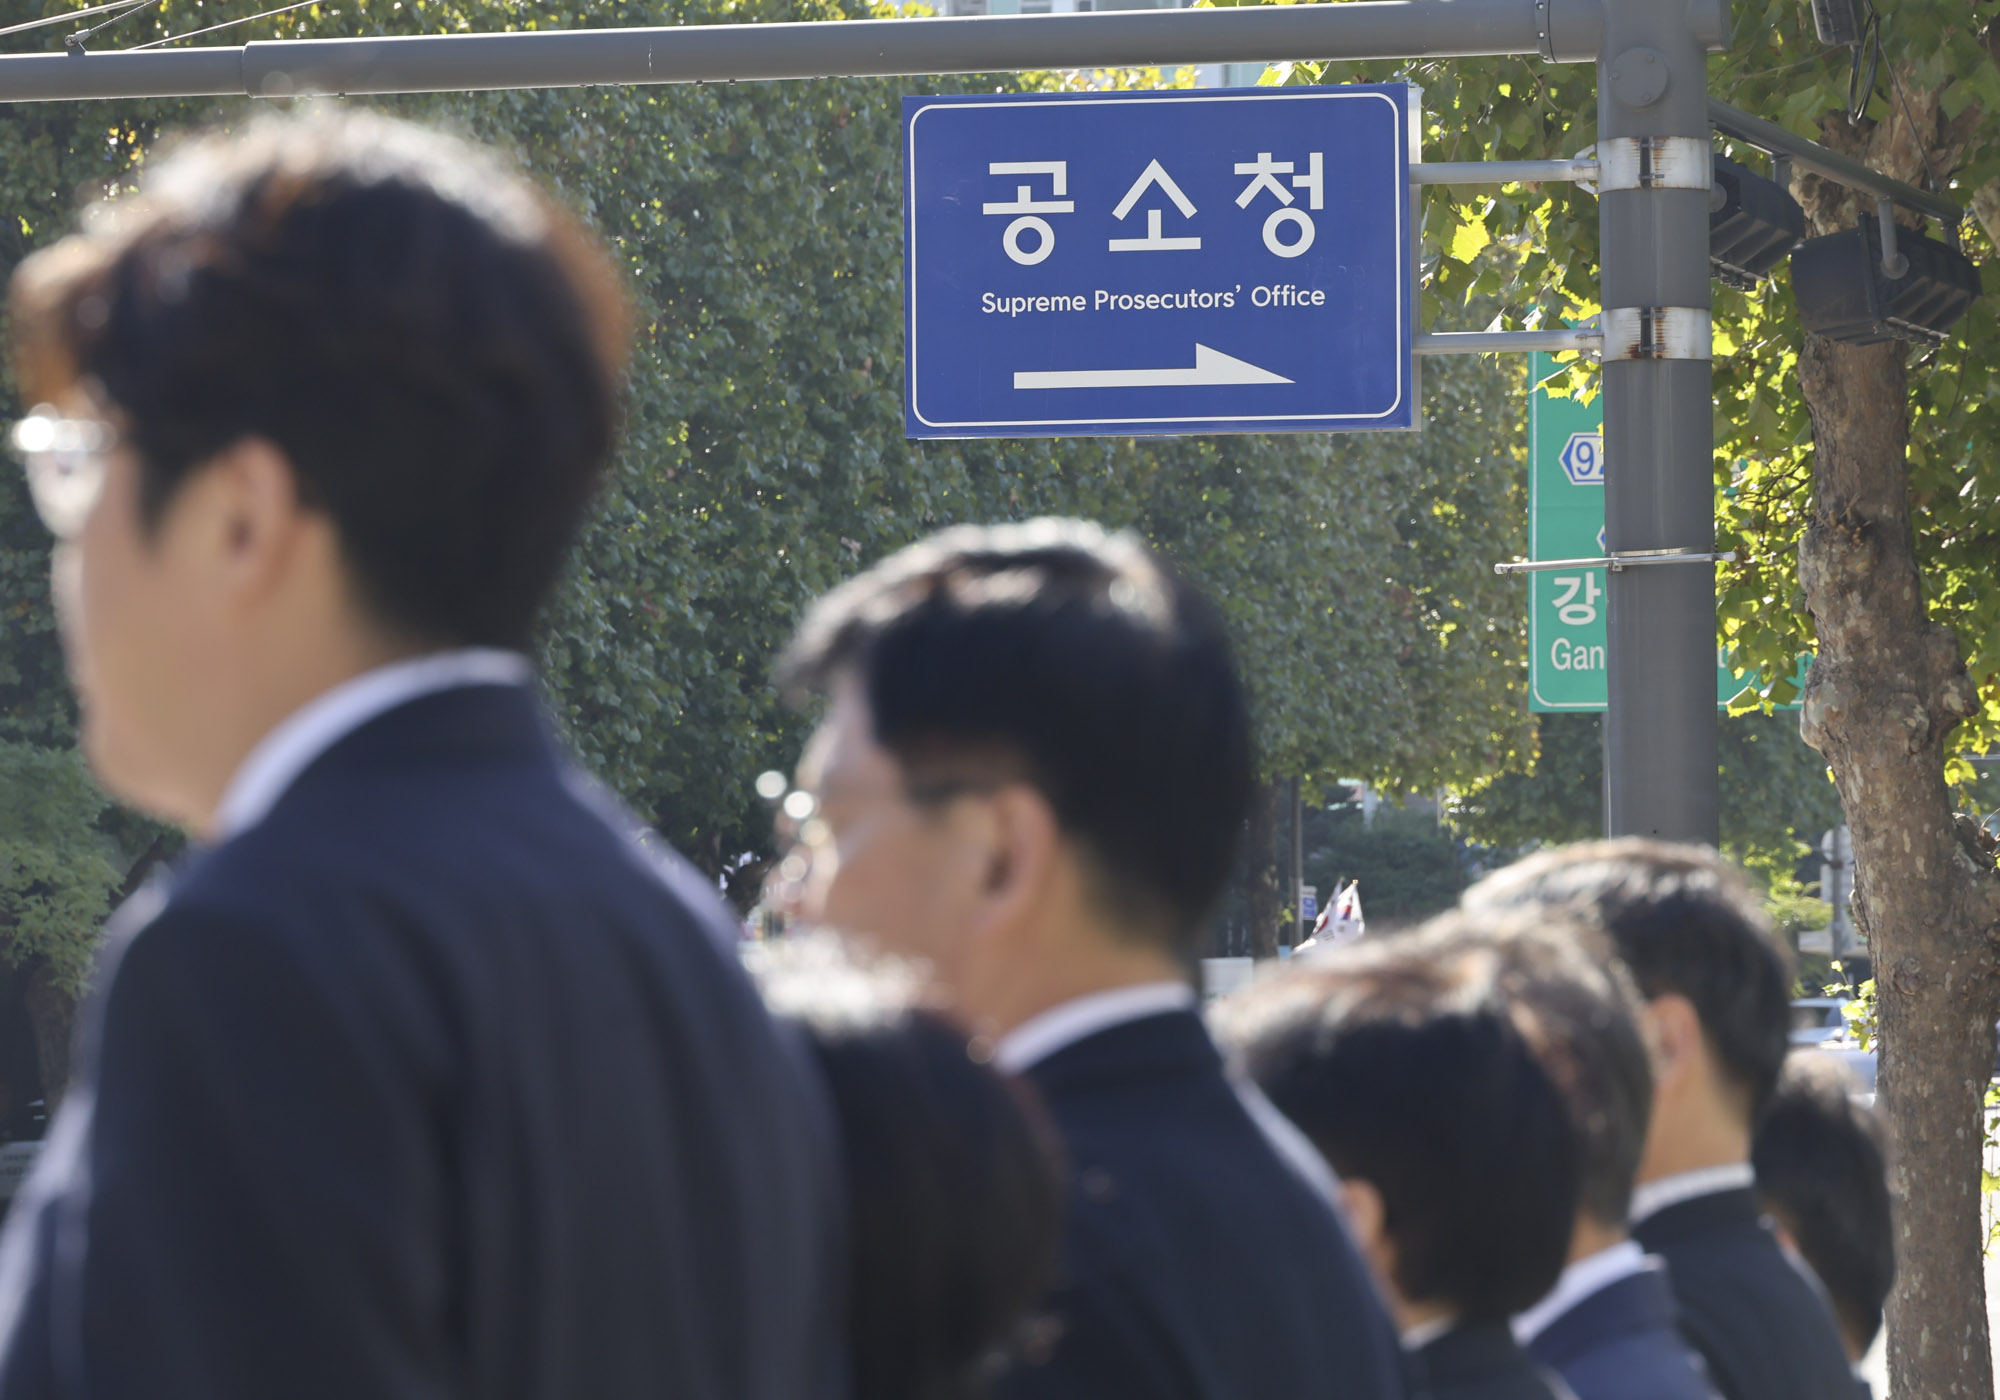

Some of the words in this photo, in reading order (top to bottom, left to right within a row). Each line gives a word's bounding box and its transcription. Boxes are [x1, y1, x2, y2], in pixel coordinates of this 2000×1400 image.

[982, 151, 1324, 267] 공소청
[981, 292, 1087, 318] Supreme
[1251, 284, 1326, 308] Office
[1576, 441, 1604, 476] 9
[1551, 571, 1602, 626] 강
